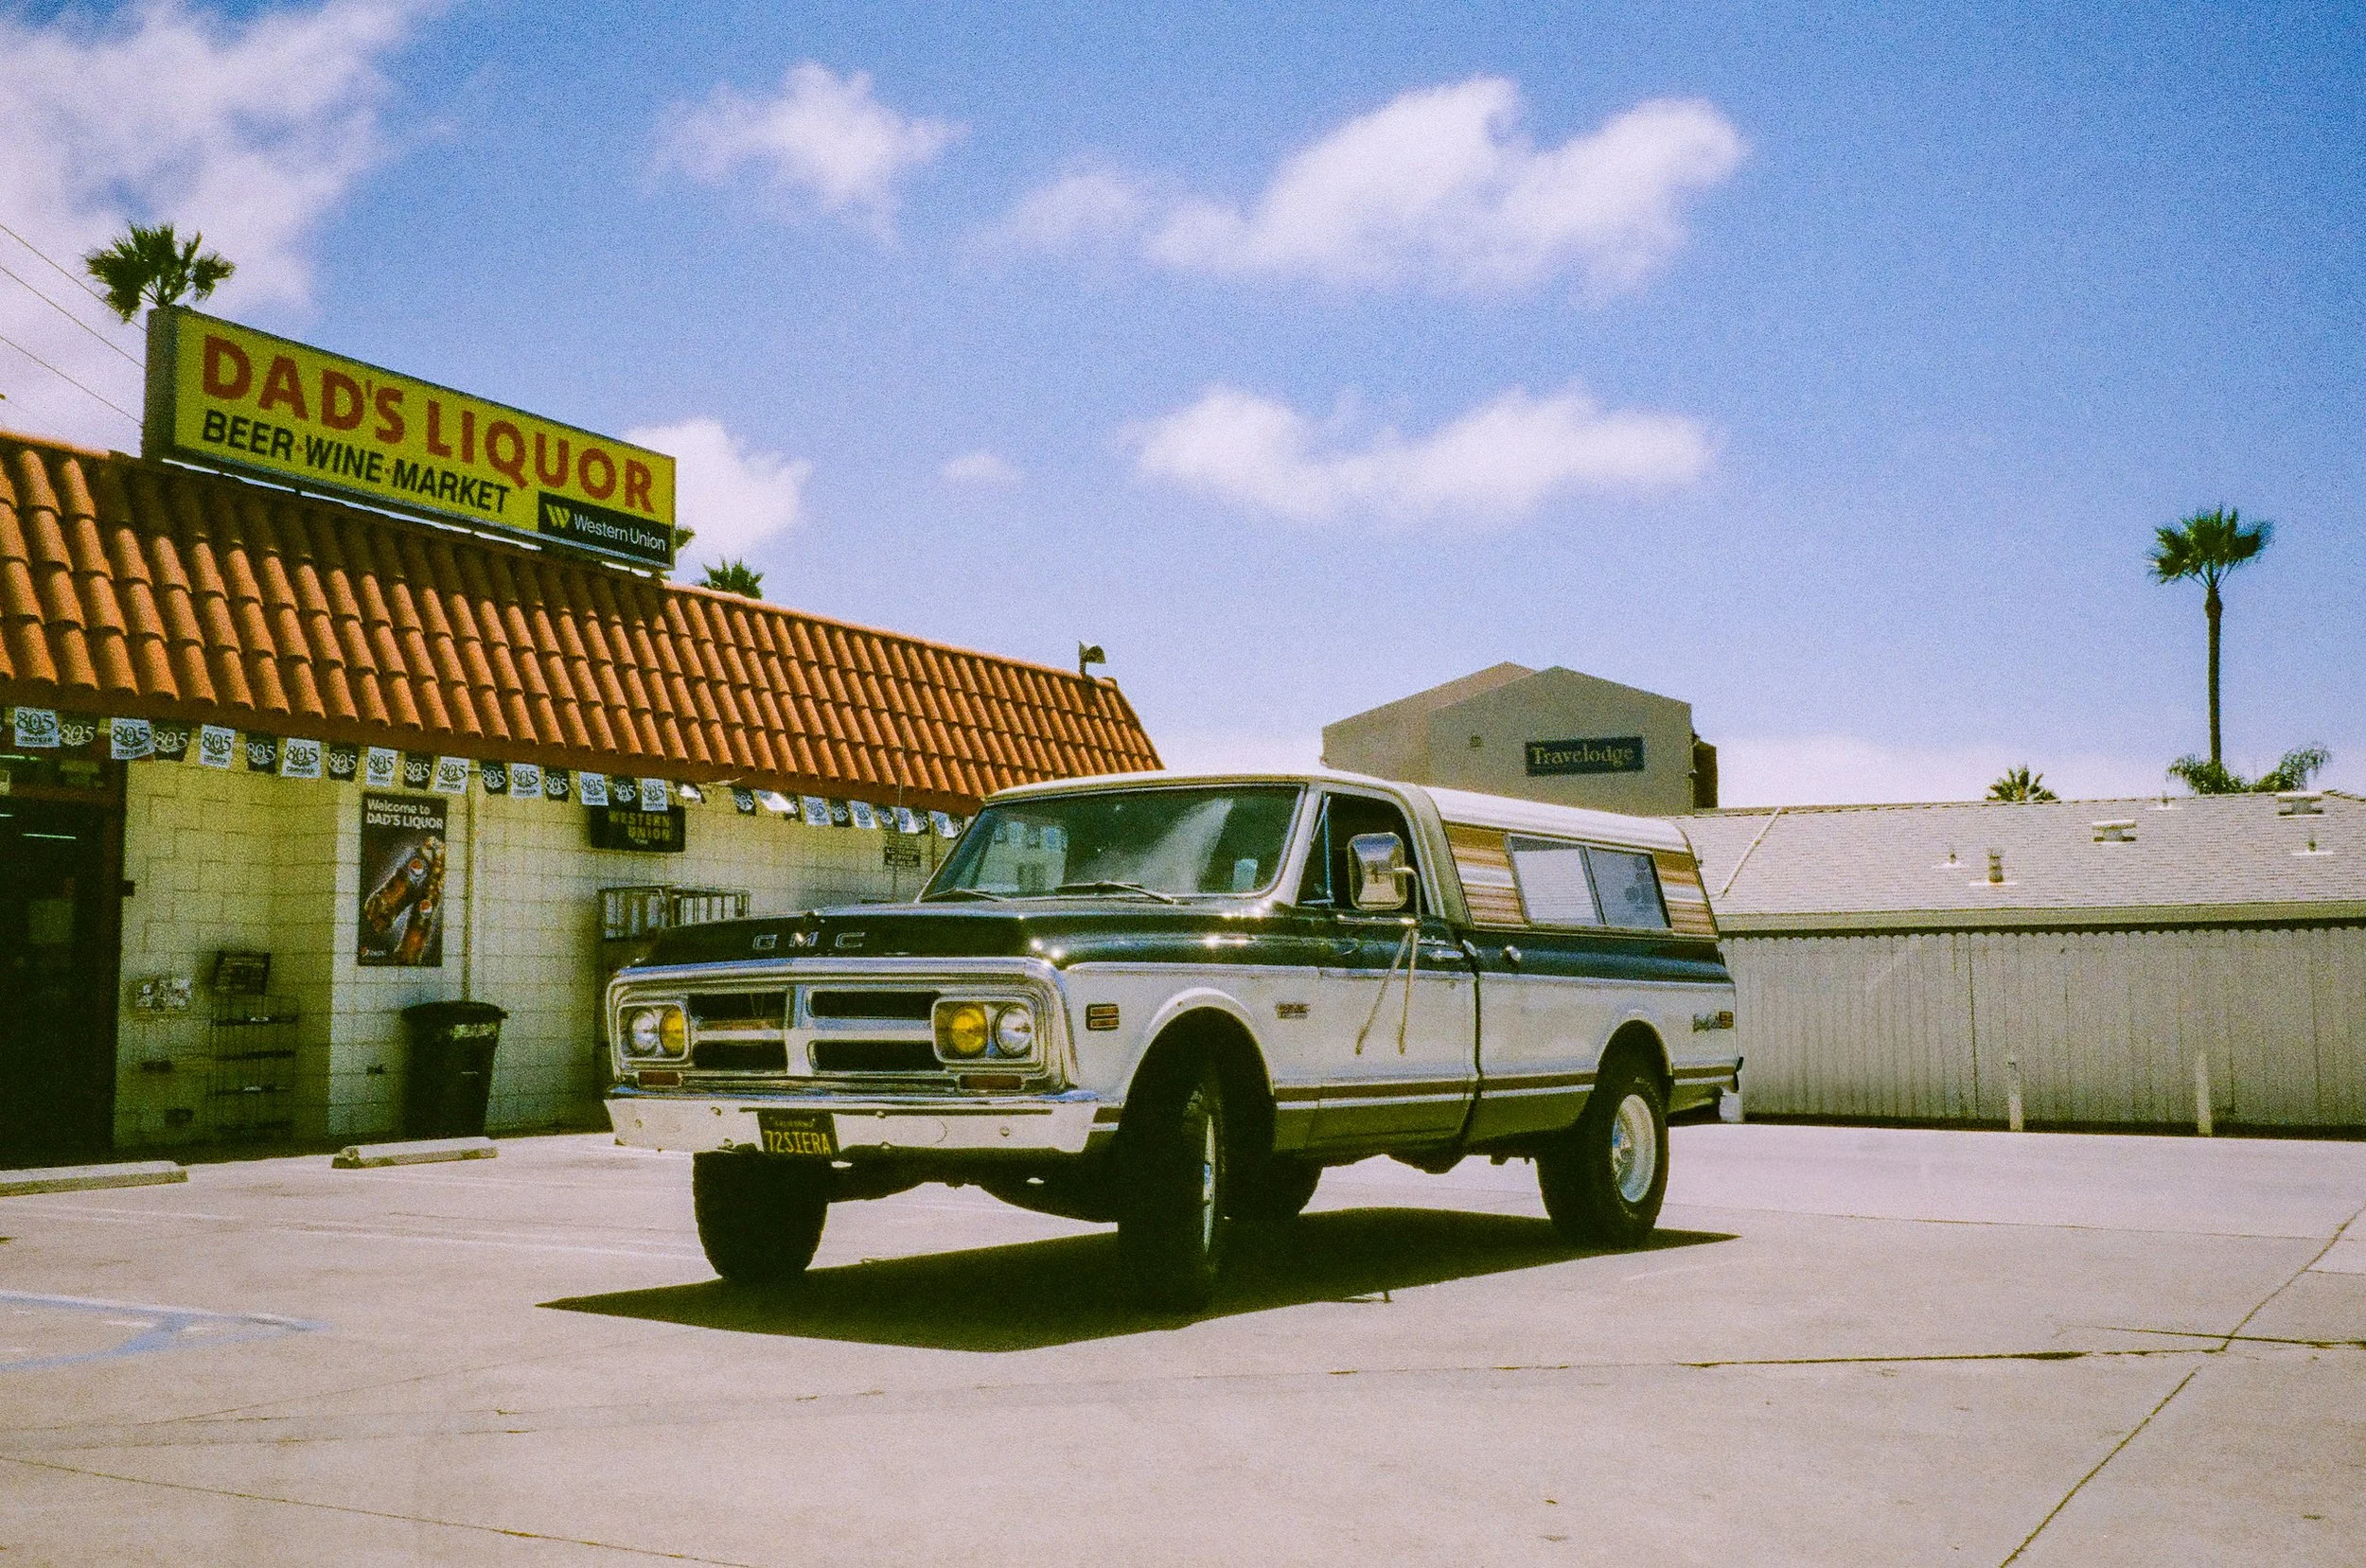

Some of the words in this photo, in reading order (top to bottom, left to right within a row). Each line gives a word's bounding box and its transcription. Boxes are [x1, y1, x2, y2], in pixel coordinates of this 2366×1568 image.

[203, 334, 405, 444] DAD'S
[428, 398, 655, 514] LIQUOR
[203, 409, 293, 461] BEER
[306, 434, 383, 484] WINE
[393, 458, 510, 513] MARKET
[574, 513, 628, 542] Western
[629, 527, 665, 552] Union
[16, 711, 55, 731] 805
[59, 724, 95, 743] 805
[113, 726, 153, 744] 805
[154, 731, 188, 749] 805
[202, 731, 232, 752] 805
[247, 742, 275, 761] 805
[286, 746, 319, 763] 805
[1530, 744, 1633, 768] Travelodge
[328, 752, 357, 770] 805
[368, 754, 394, 771] 805
[404, 762, 431, 778] 805
[438, 763, 467, 778] 805
[481, 768, 506, 785] 805
[513, 769, 539, 785] 805
[545, 776, 568, 792] 805
[581, 778, 605, 792] 805
[367, 799, 417, 814] Welcome
[419, 804, 431, 815] to
[366, 812, 400, 826] DAD'S
[402, 815, 443, 830] LIQUOR
[764, 1130, 832, 1154] 72SIERA
